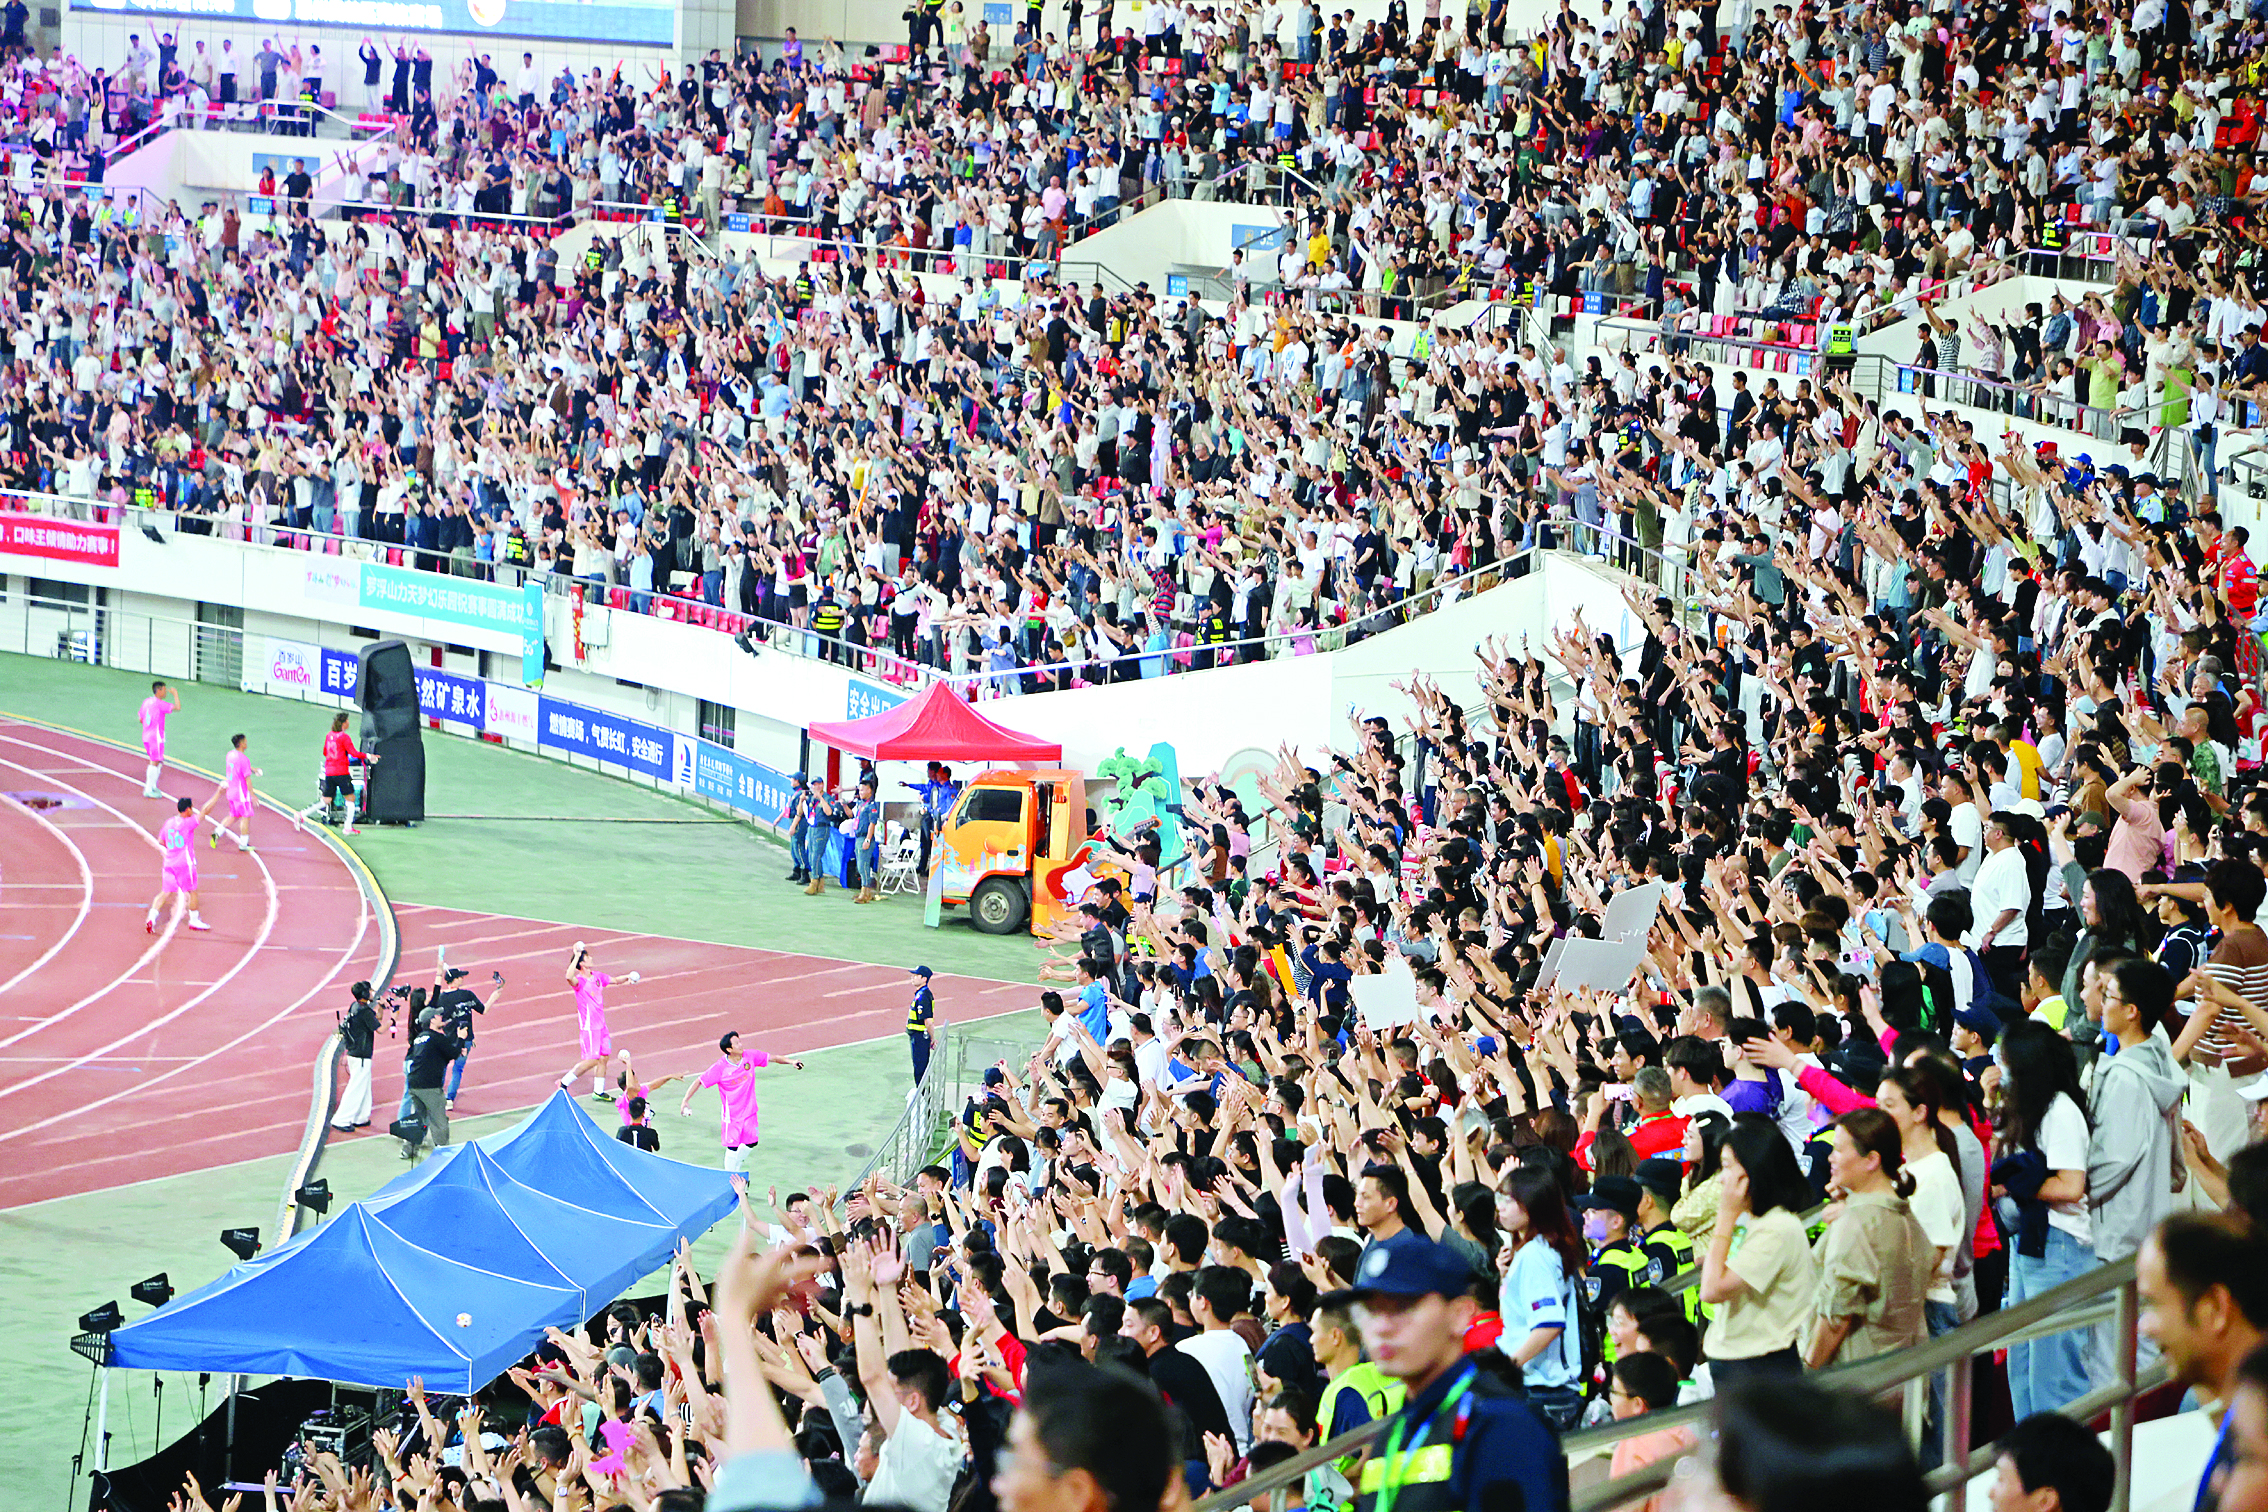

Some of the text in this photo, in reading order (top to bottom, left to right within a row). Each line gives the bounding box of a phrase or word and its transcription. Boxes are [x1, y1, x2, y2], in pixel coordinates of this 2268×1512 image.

[327, 658, 481, 718] 百岁 然矿泉水
[739, 773, 791, 812] 全国优秀律师
[167, 829, 184, 849] 56
